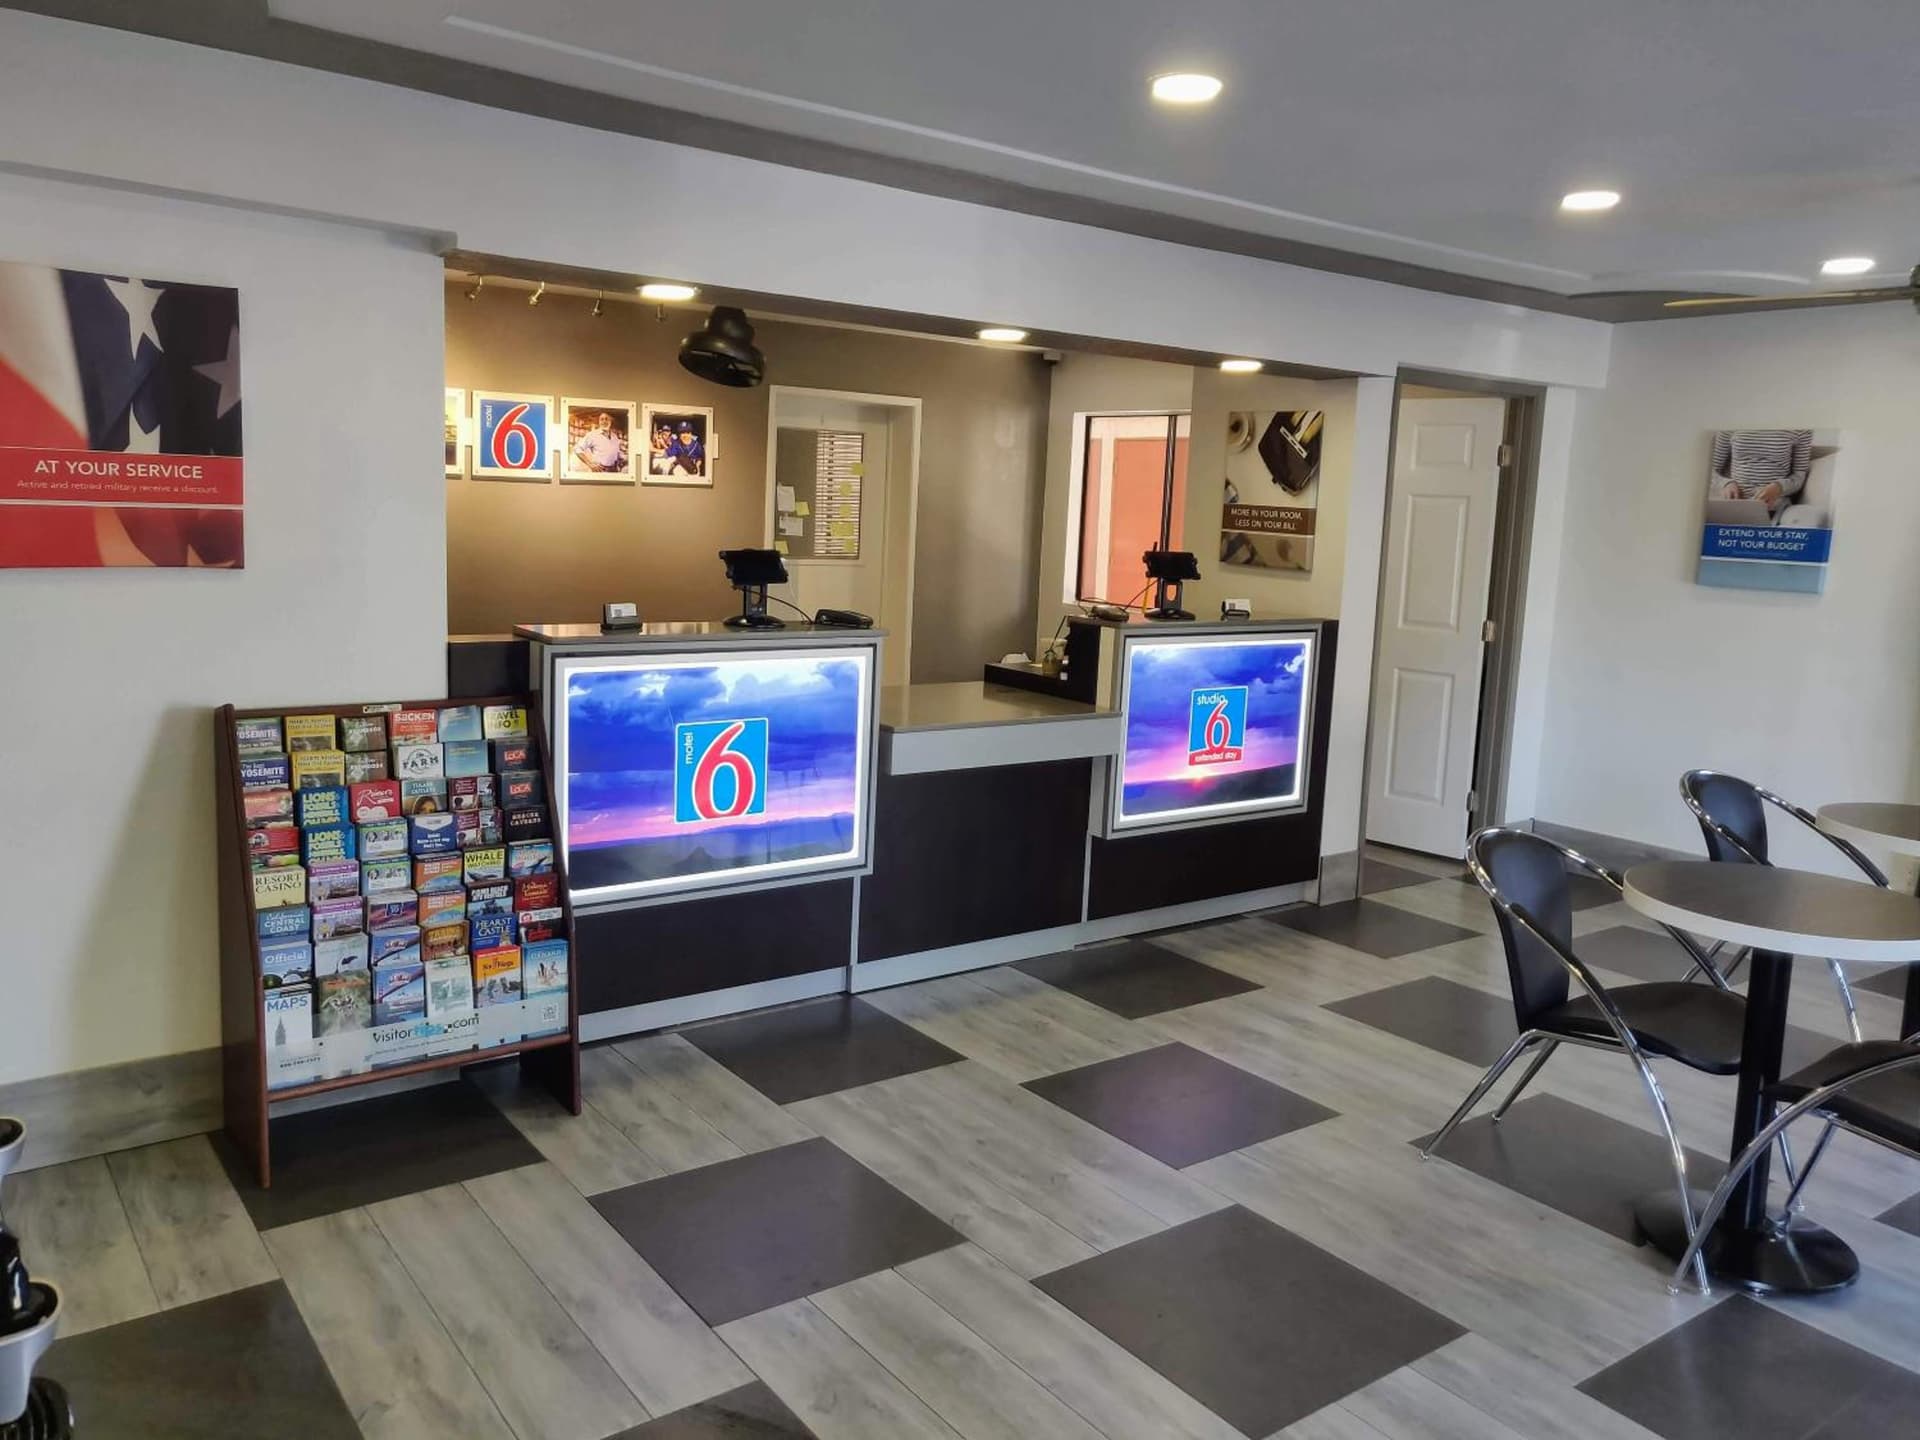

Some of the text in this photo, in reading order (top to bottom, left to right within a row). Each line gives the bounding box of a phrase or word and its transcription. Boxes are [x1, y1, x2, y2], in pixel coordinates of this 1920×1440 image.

[491, 403, 538, 469] 6
[35, 460, 203, 479] AT YOUR SERVICE
[17, 480, 48, 489] Active
[50, 481, 69, 489] and
[104, 483, 136, 493] military
[139, 485, 171, 493] receive
[1231, 508, 1250, 516] MORE
[1260, 510, 1278, 518] YOUR
[1235, 519, 1250, 527] LESS
[1263, 521, 1281, 529] YOUR
[1718, 528, 1754, 538] EXTEND
[1757, 530, 1783, 538] YOUR
[1718, 539, 1805, 551] NOT YOUR BUDGET
[1197, 692, 1226, 705] studio
[1204, 699, 1231, 750] 6
[683, 732, 694, 764] motel
[403, 756, 439, 769] FARM
[240, 766, 284, 778] YOSEMITE
[692, 721, 756, 819] 6
[466, 851, 504, 862] WHALE
[255, 873, 301, 886] RESORT
[255, 881, 302, 895] CASINO
[264, 918, 304, 928] CENTRAL
[270, 925, 299, 934] COAST
[475, 918, 512, 929] HEARST
[478, 926, 510, 937] CASTLE
[265, 950, 307, 964] Official
[267, 996, 308, 1012] MAPS
